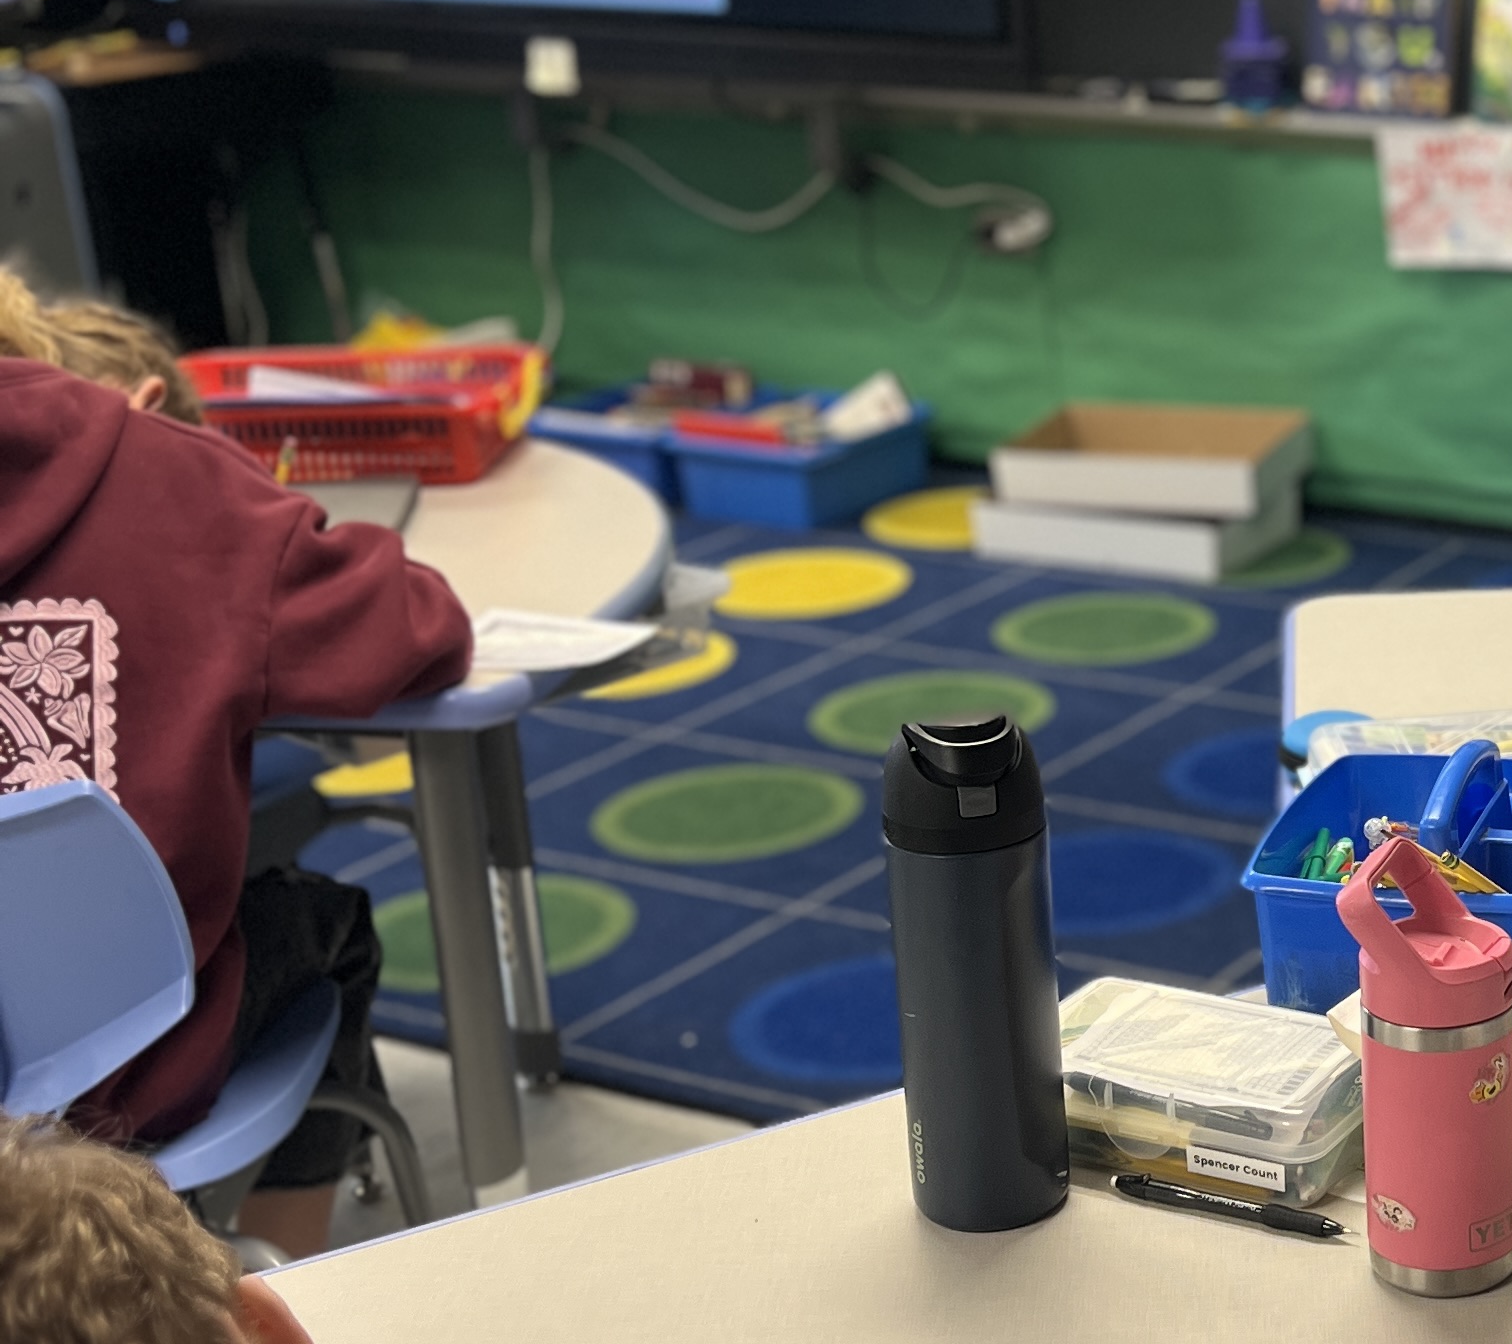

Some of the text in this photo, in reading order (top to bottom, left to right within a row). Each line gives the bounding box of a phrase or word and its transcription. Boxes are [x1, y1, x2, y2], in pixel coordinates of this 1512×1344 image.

[911, 1121, 926, 1184] owala
[1193, 1154, 1279, 1181] Spencer Count
